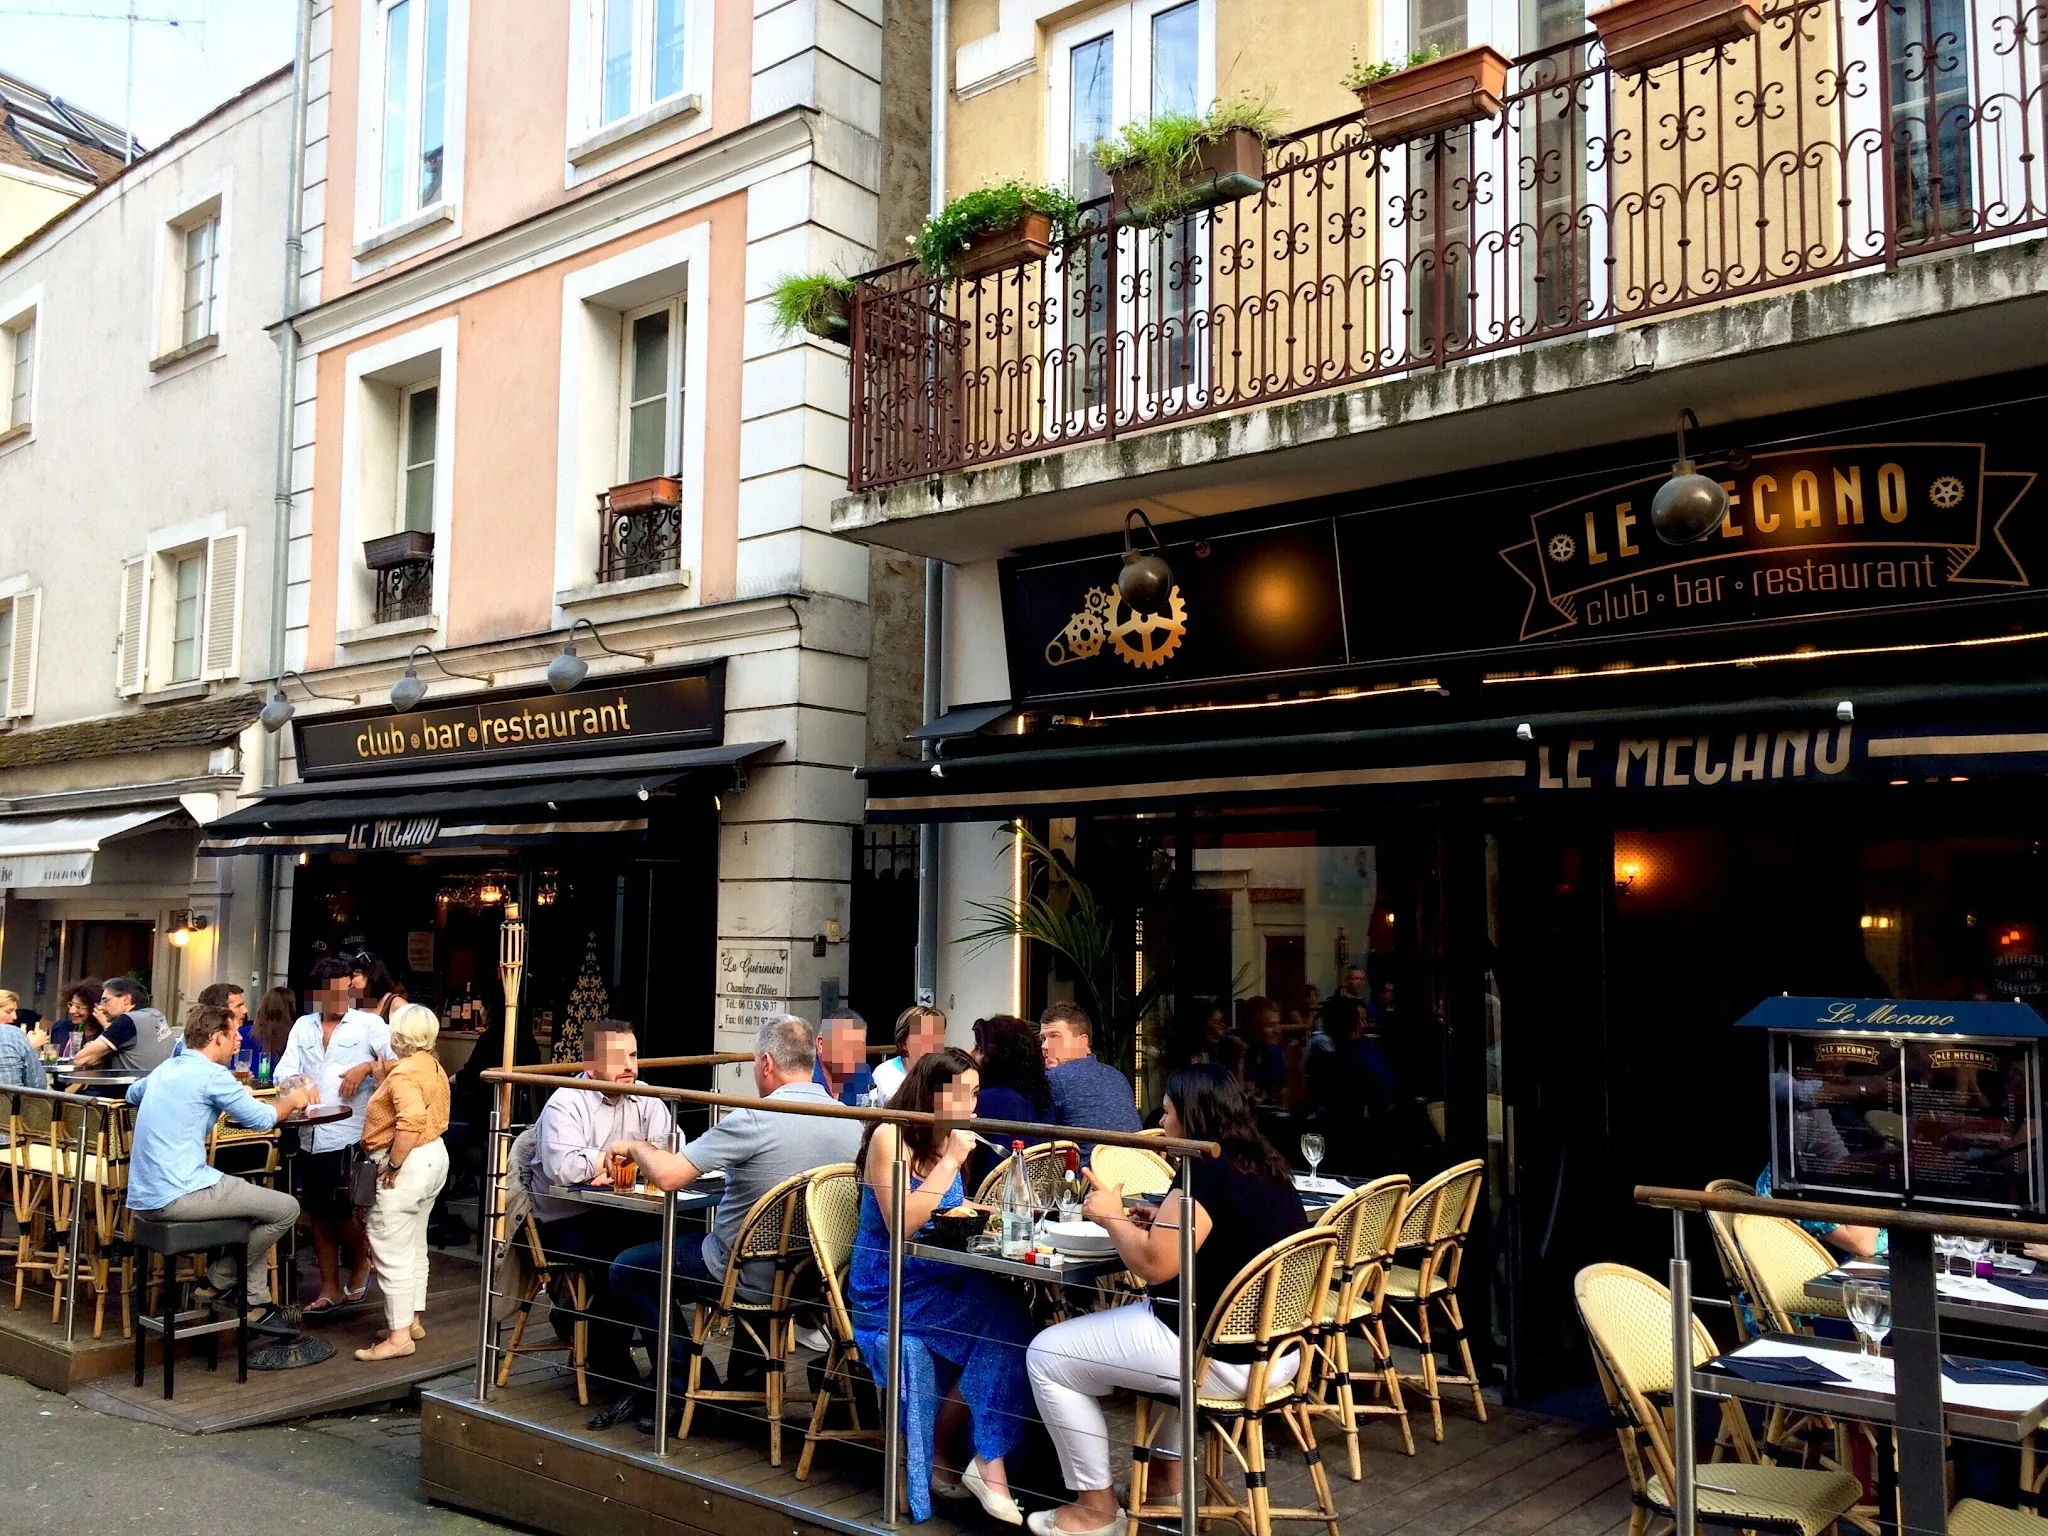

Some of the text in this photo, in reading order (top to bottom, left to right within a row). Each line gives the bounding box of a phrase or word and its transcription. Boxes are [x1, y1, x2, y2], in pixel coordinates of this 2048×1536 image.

[1585, 463, 1908, 565] LE ECANO
[1587, 555, 1937, 627] club bar restaurant
[356, 697, 631, 758] club bar restaurant
[1538, 740, 1595, 789] LE
[723, 956, 738, 973] La
[726, 982, 754, 994] Chambres
[1817, 1002, 1955, 1026] Le Mecano
